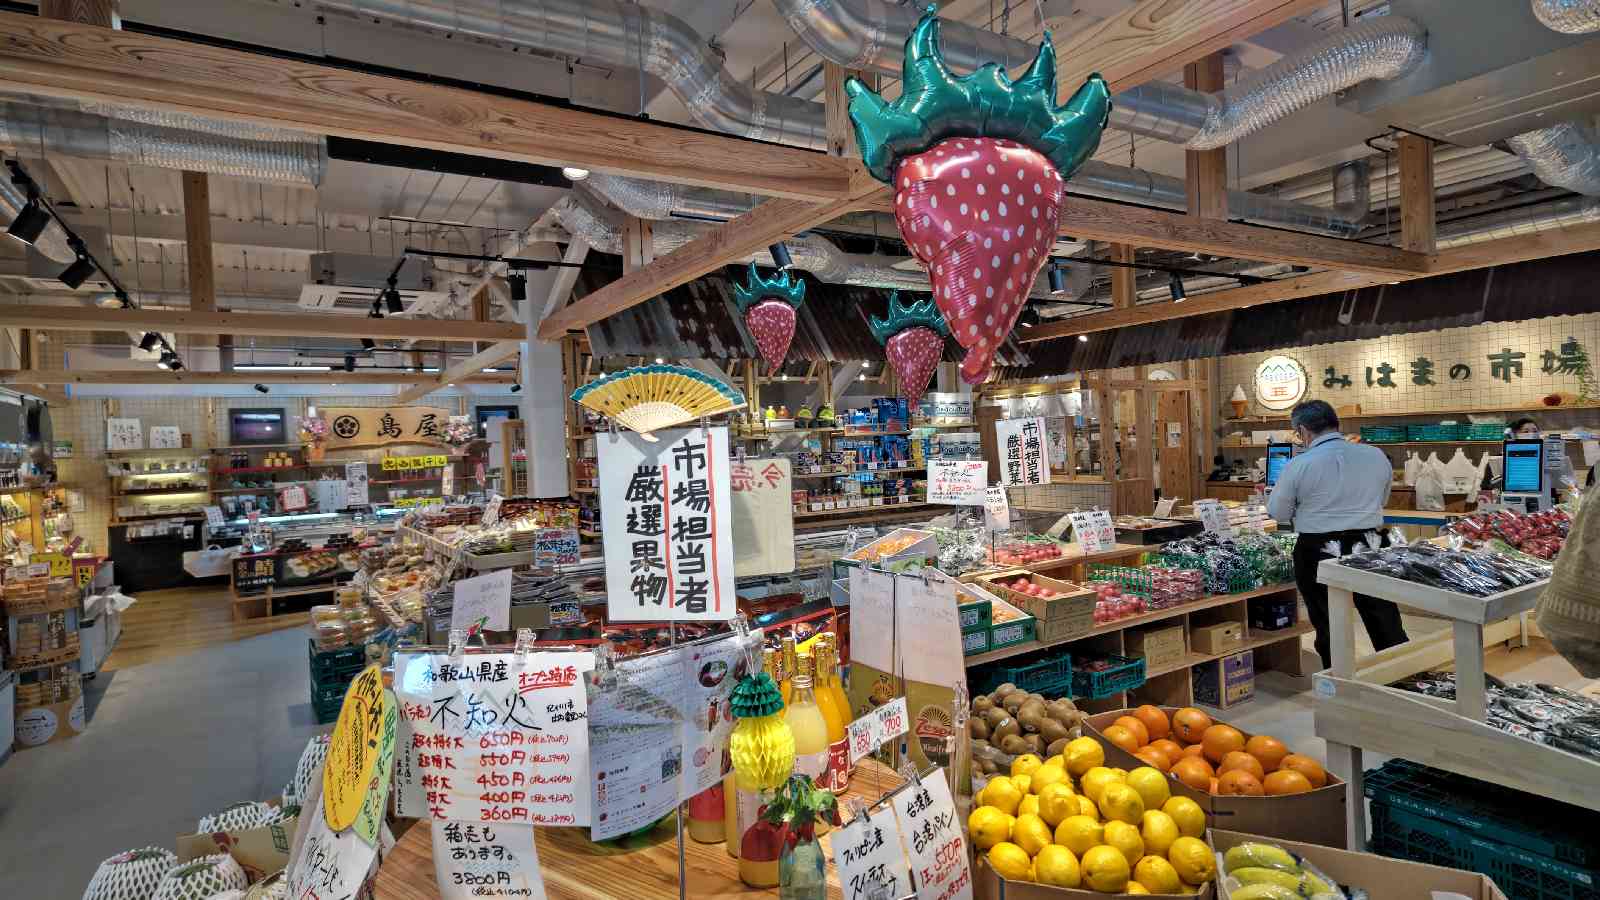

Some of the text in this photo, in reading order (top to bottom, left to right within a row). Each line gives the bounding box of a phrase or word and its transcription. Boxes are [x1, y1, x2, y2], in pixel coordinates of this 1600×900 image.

[1322, 336, 1586, 389] みはまの市場
[1007, 433, 1024, 485] 厳選野菜
[1023, 422, 1041, 484] 市場担当者
[624, 465, 668, 607] 厳選果物
[671, 438, 712, 613] 市場担当者
[423, 660, 508, 682] 和歌山県産
[430, 693, 543, 731] 不知火
[480, 731, 524, 749] 650円
[480, 750, 526, 765] 550円
[477, 771, 525, 788] 450円
[480, 791, 526, 804] 400円
[429, 807, 448, 820] 大
[480, 806, 528, 821] 360円
[451, 845, 513, 861] あります。
[843, 827, 884, 867] フィリピン産
[452, 871, 511, 885] 3800円
